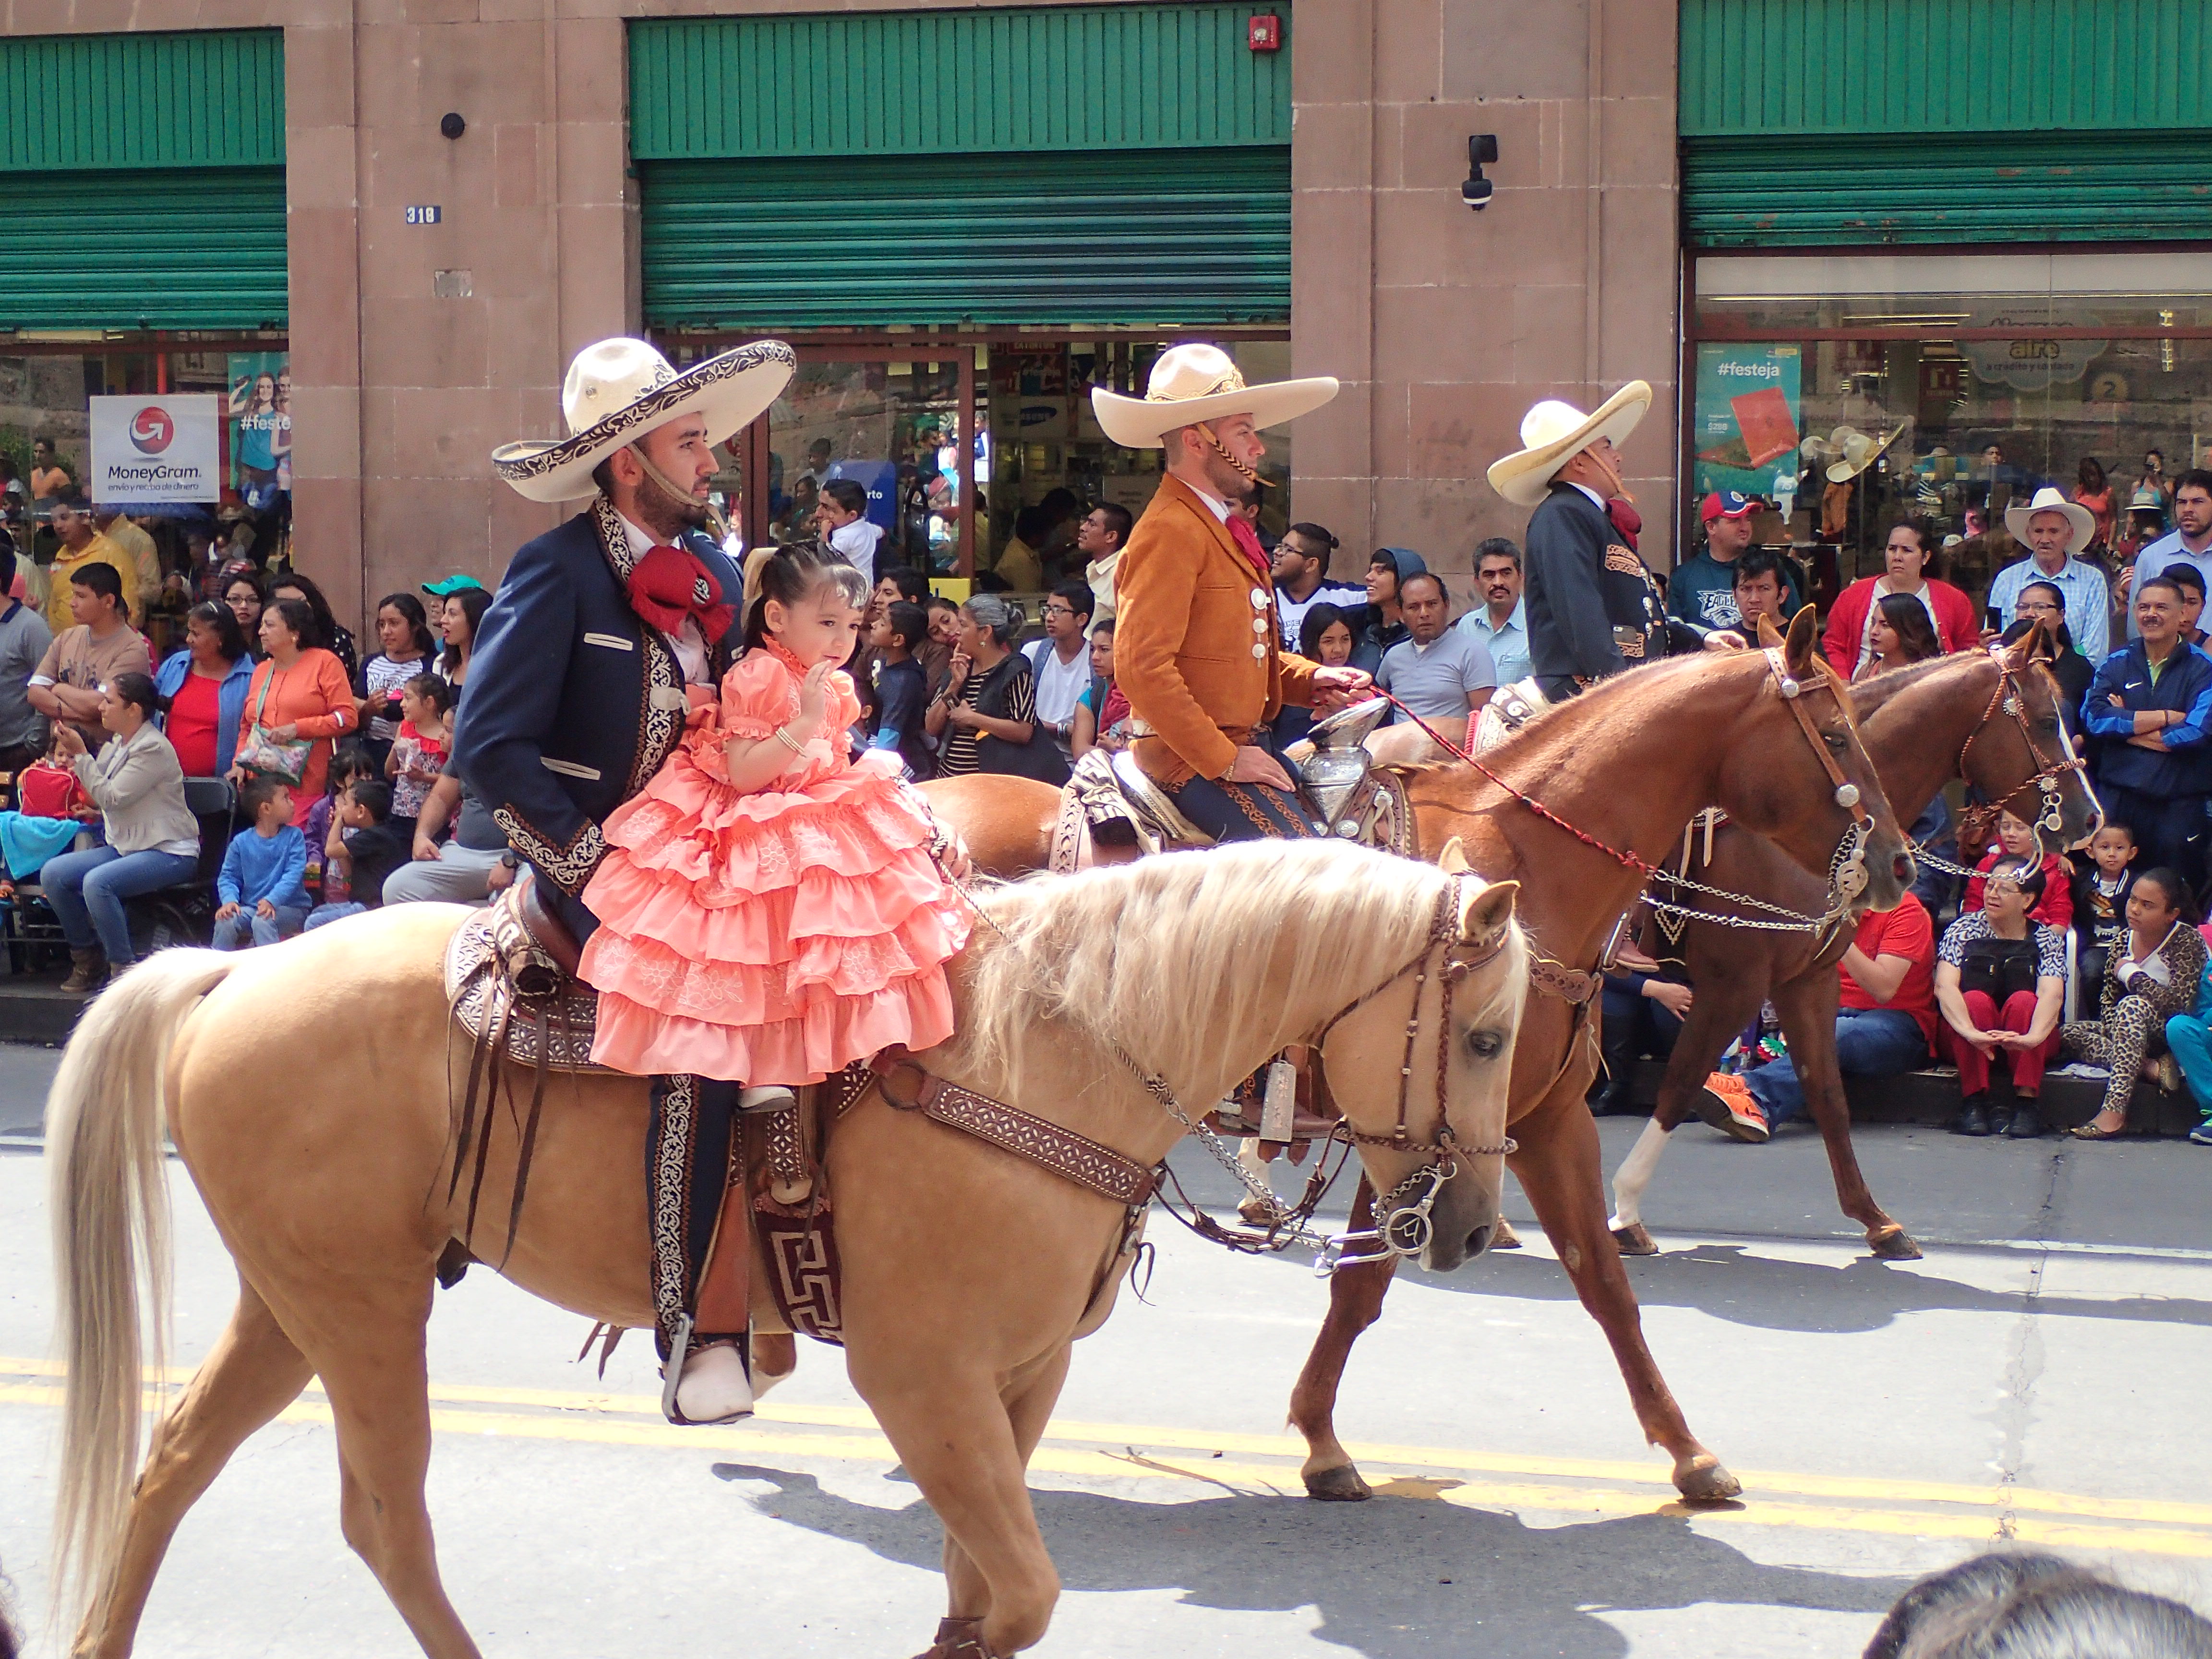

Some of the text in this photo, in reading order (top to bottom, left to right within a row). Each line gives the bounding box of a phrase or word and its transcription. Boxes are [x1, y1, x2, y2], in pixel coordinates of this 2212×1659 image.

[1717, 361, 1780, 380] #festeja
[240, 415, 291, 431] #feste
[108, 465, 198, 482] MoneyGram
[866, 490, 883, 499] rto
[1703, 593, 1737, 612] EAGLE
